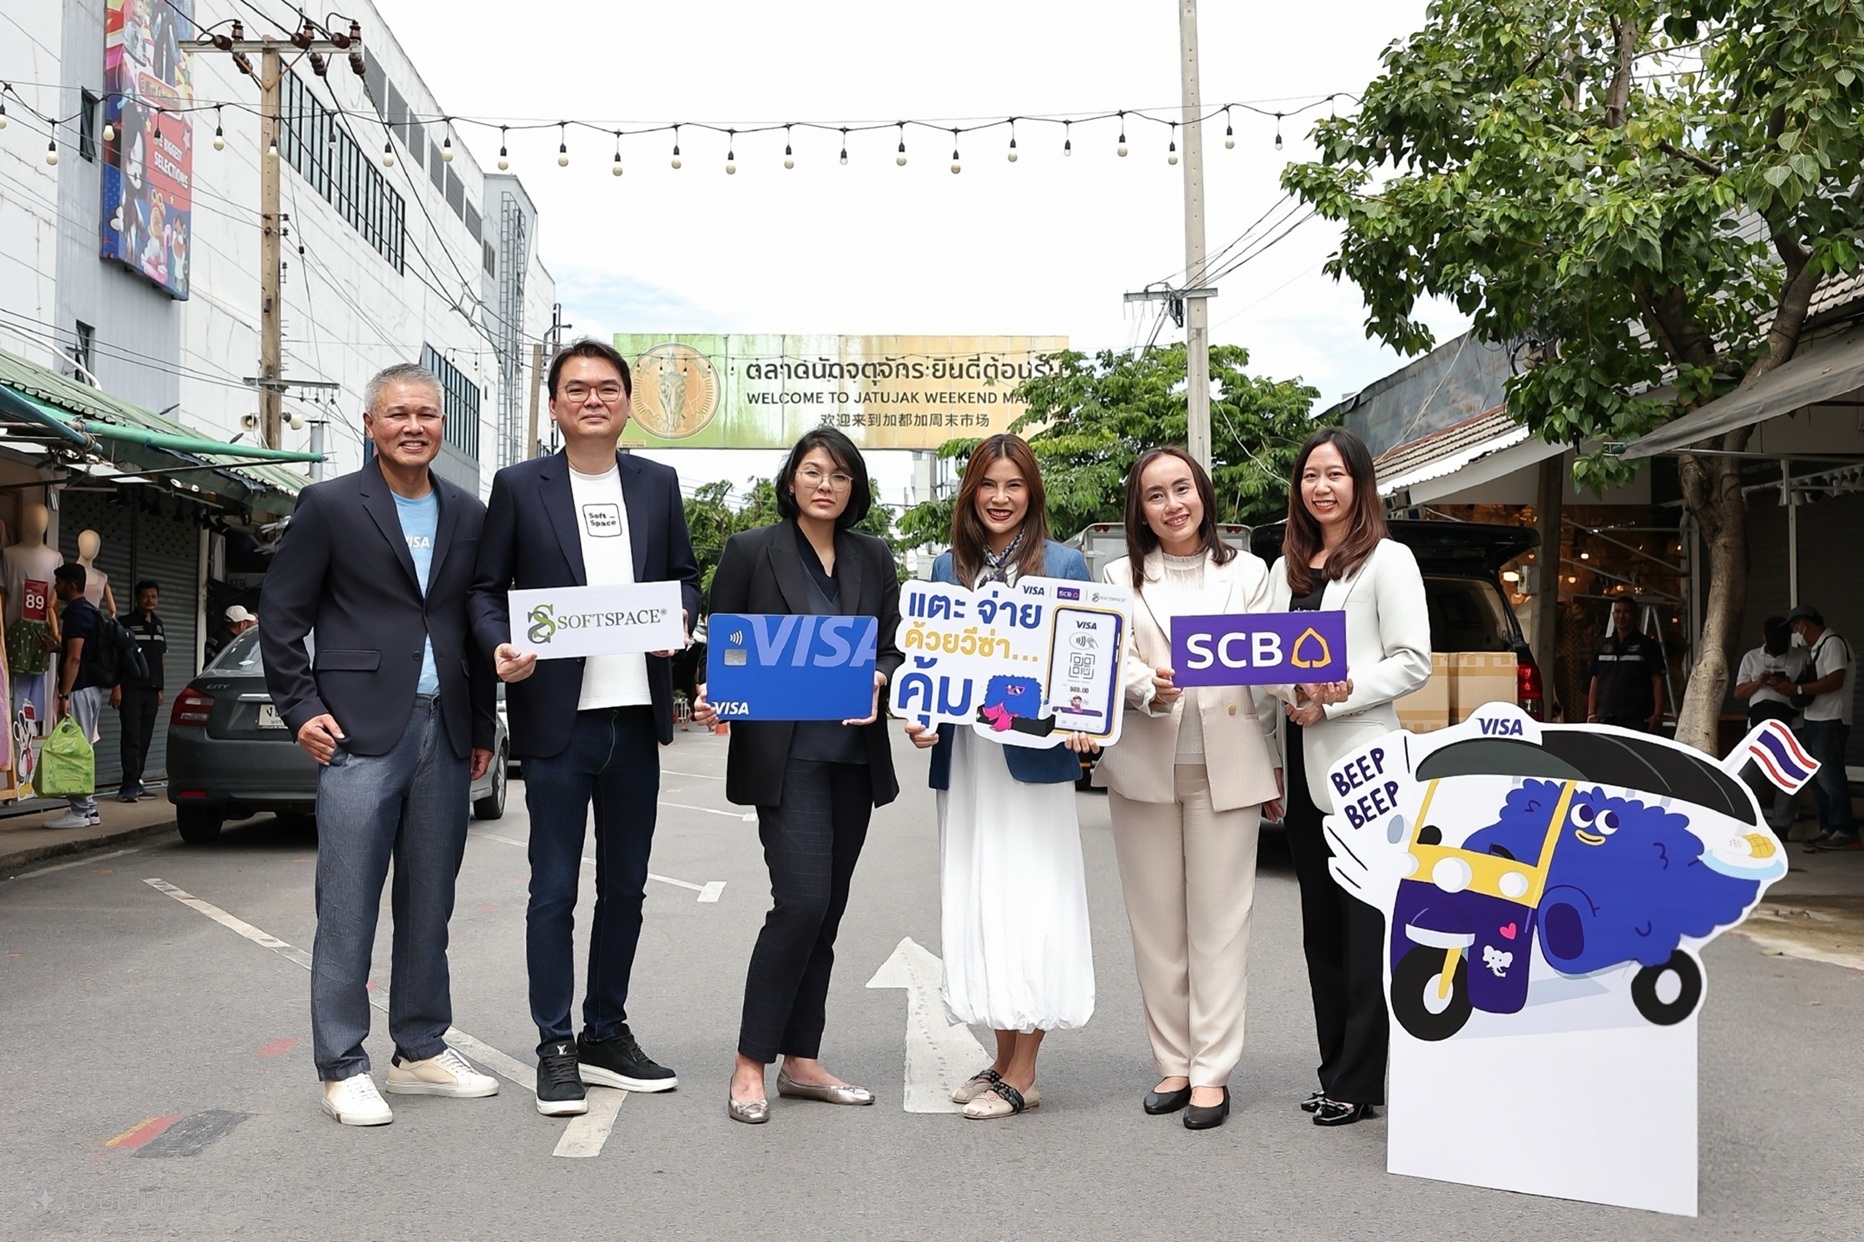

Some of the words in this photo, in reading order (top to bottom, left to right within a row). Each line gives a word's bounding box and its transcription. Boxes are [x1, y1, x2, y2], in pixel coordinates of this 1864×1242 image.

[747, 392, 824, 405] WELCOME
[828, 392, 849, 404] TO
[854, 391, 920, 404] JATUJAK
[925, 391, 998, 404] WEEKEND
[821, 413, 990, 427] 欢迎来到加都加周末市场
[590, 520, 617, 528] Space
[1022, 585, 1045, 596] VISA
[25, 594, 45, 610] 89
[908, 592, 966, 621] แตะ
[977, 590, 1043, 630] จ่าย
[1076, 620, 1098, 630] VISA
[1186, 632, 1284, 669] SCB
[897, 655, 974, 729] คุ้ม
[712, 702, 750, 715] VISA
[1476, 718, 1524, 736] VISA
[1330, 747, 1385, 798] BEEP
[1344, 781, 1399, 830] BEEP
